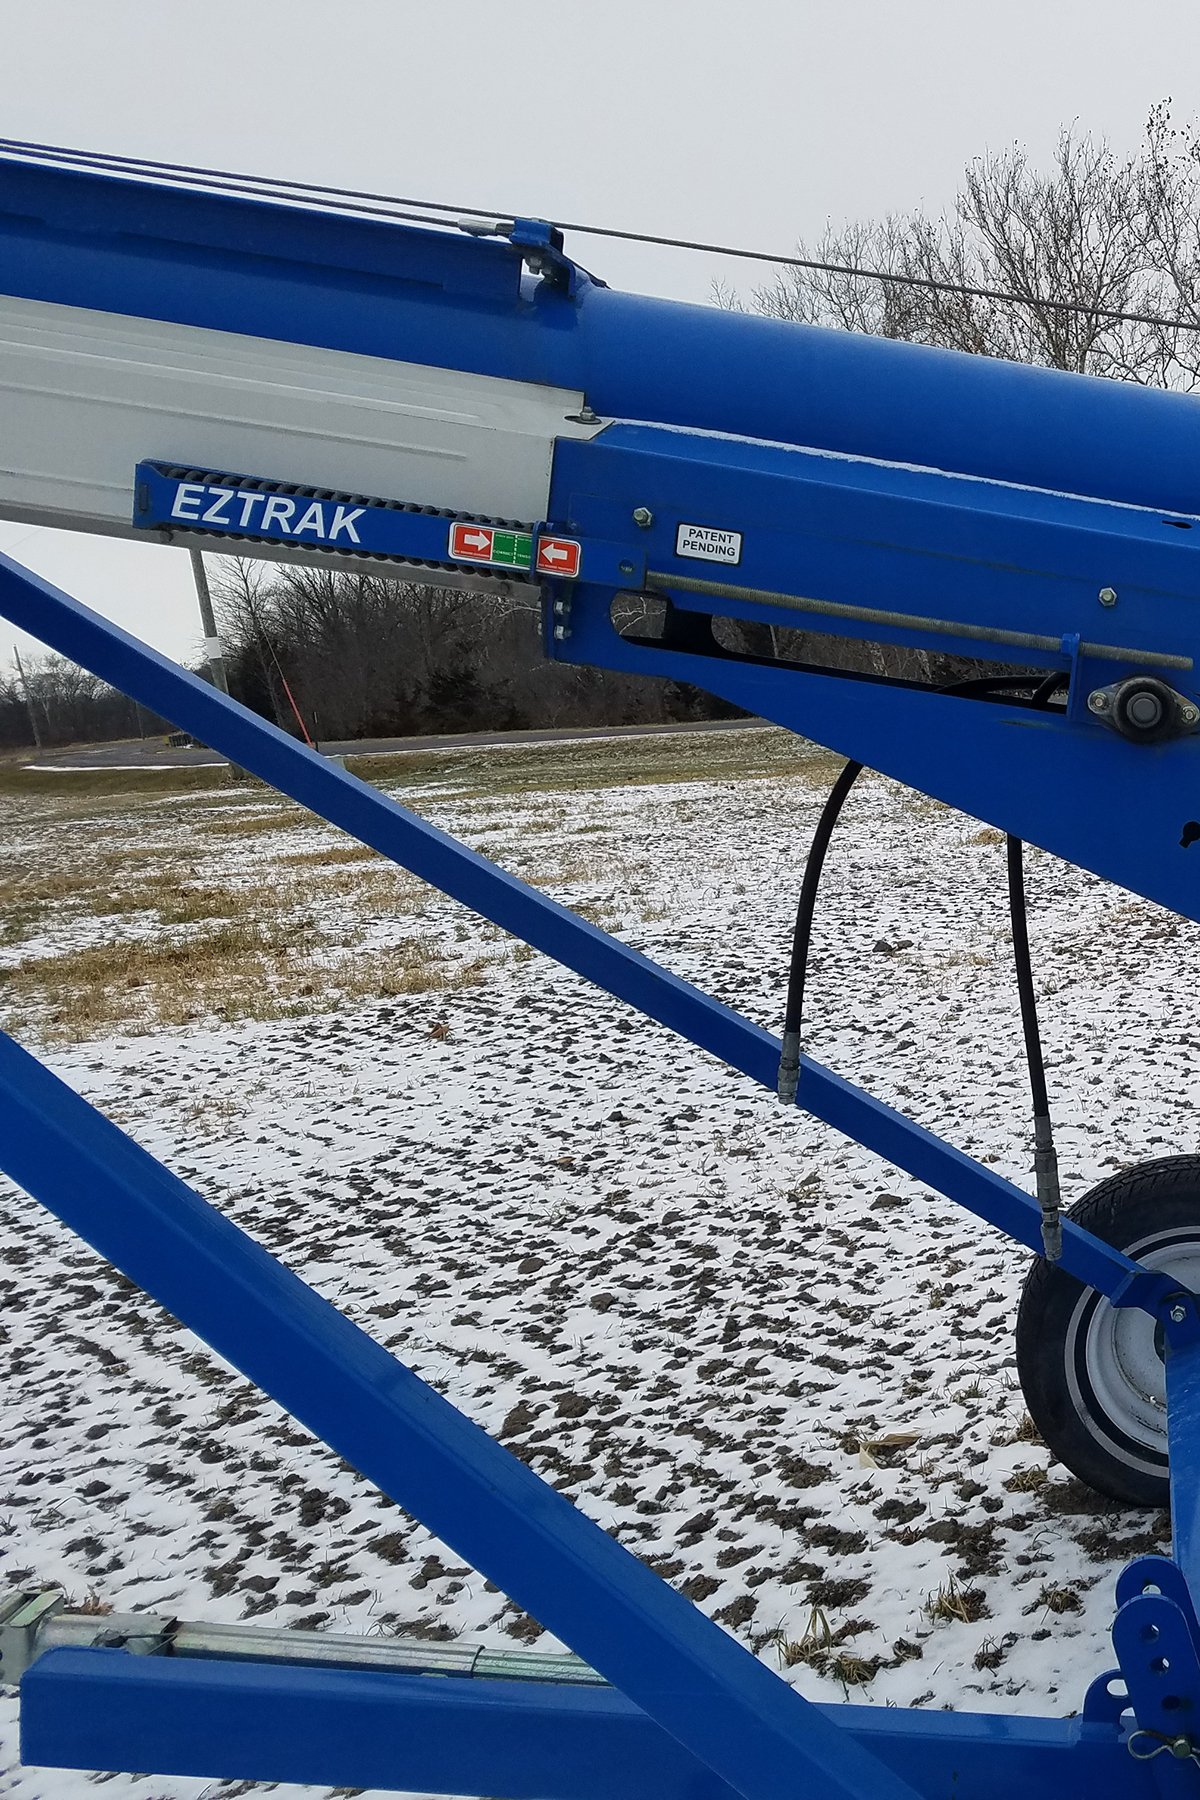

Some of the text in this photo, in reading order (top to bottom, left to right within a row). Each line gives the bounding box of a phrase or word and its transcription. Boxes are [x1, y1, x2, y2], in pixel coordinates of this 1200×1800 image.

[171, 483, 366, 543] EZTRAK
[688, 528, 735, 544] PATENT
[682, 540, 736, 556] PENDING
